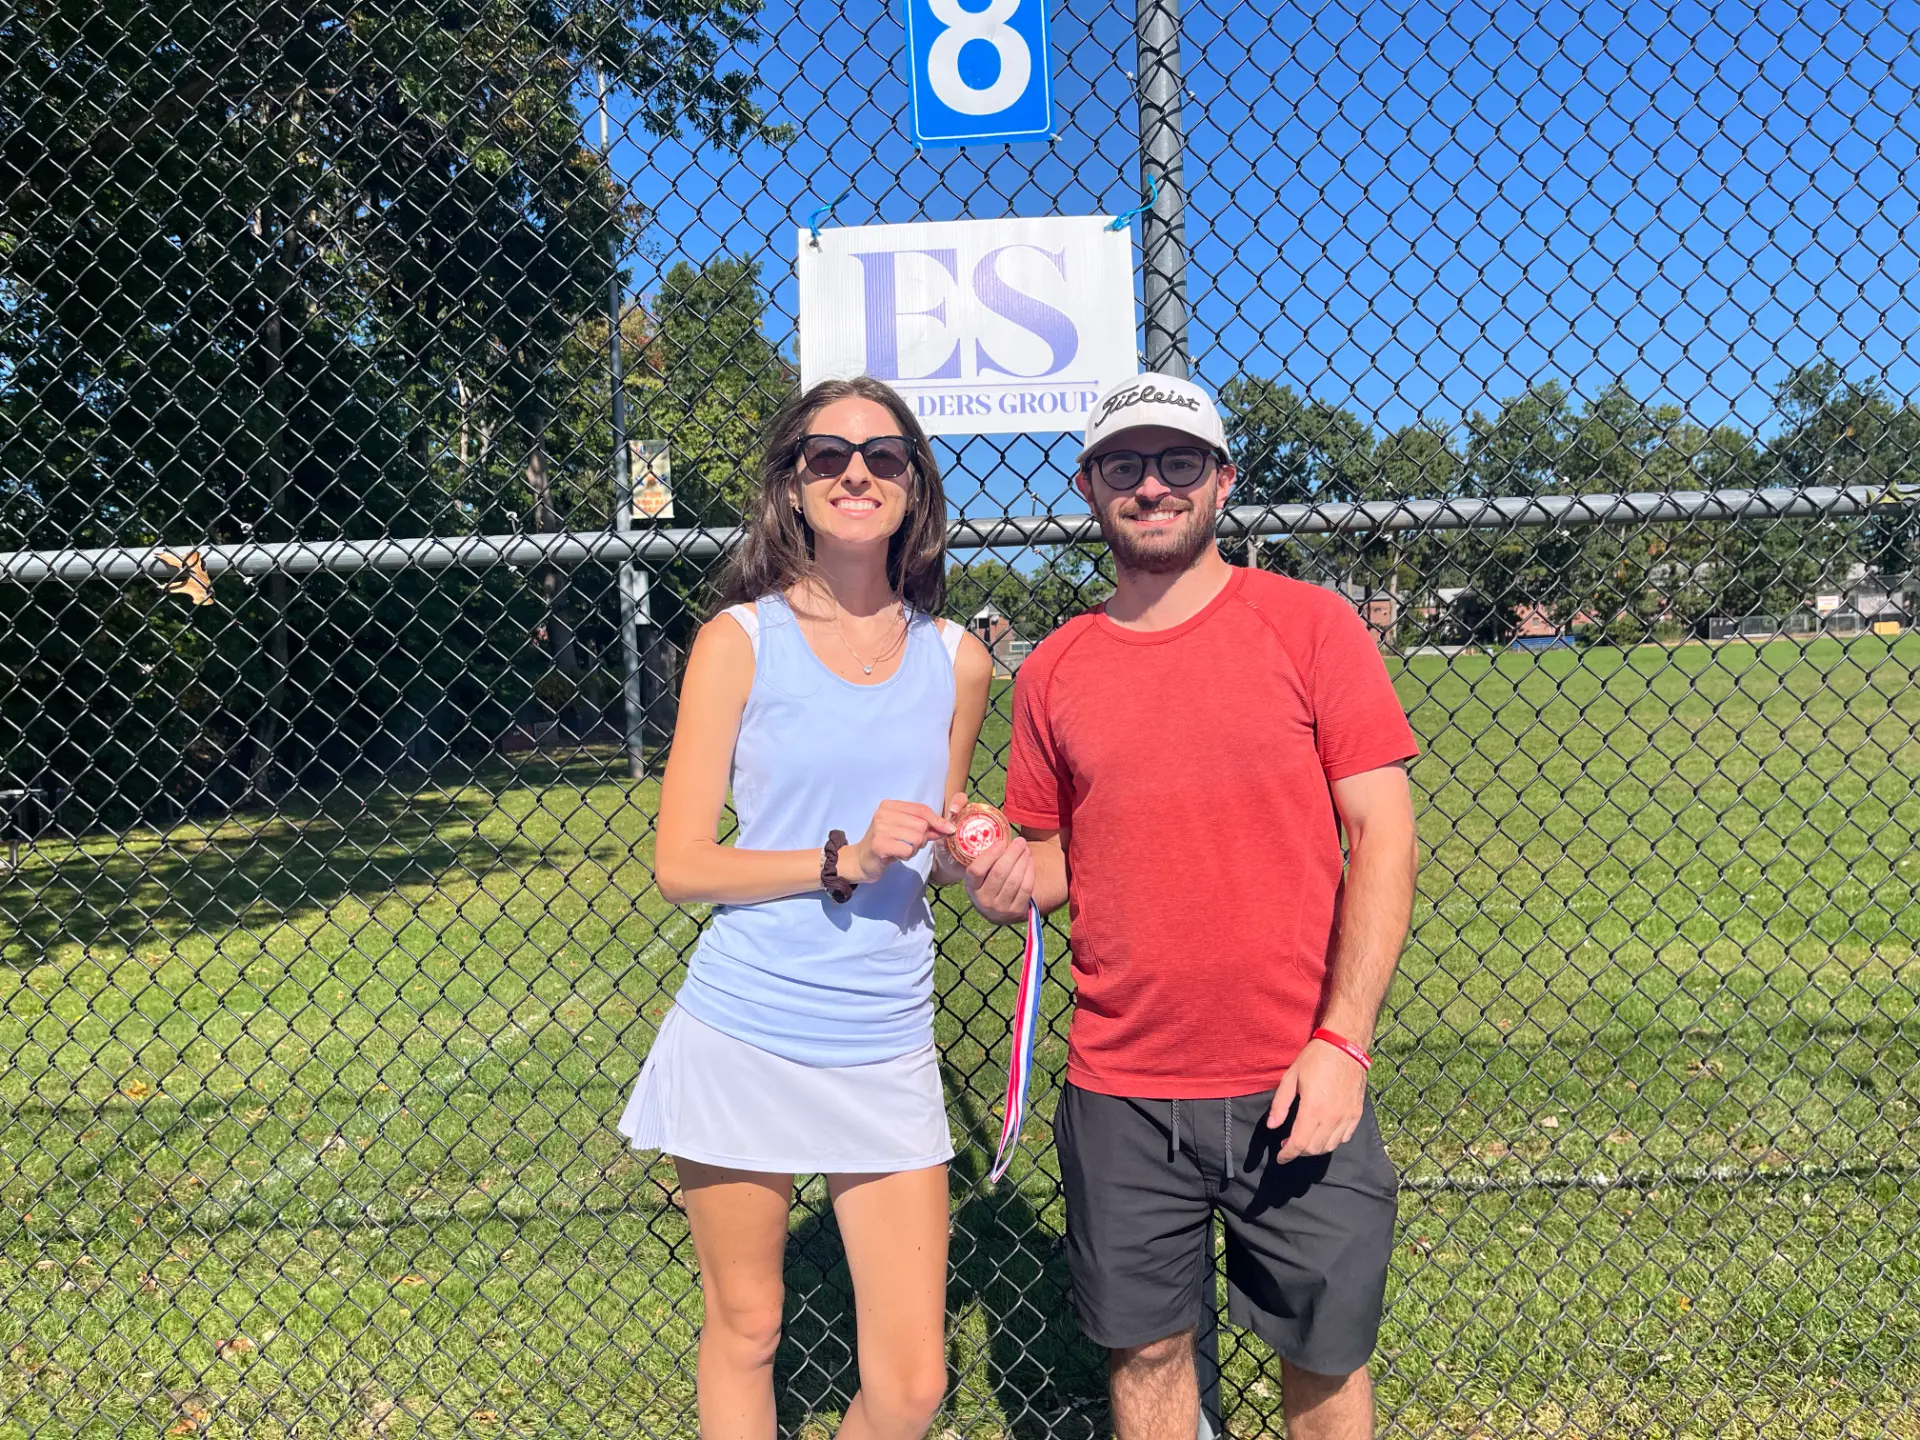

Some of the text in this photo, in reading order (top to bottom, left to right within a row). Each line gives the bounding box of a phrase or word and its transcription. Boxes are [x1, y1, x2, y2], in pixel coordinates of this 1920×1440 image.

[928, 0, 1031, 116] 8
[848, 244, 1079, 381] ES
[901, 391, 1098, 417] DERS GROUP
[1094, 384, 1201, 429] Titleist
